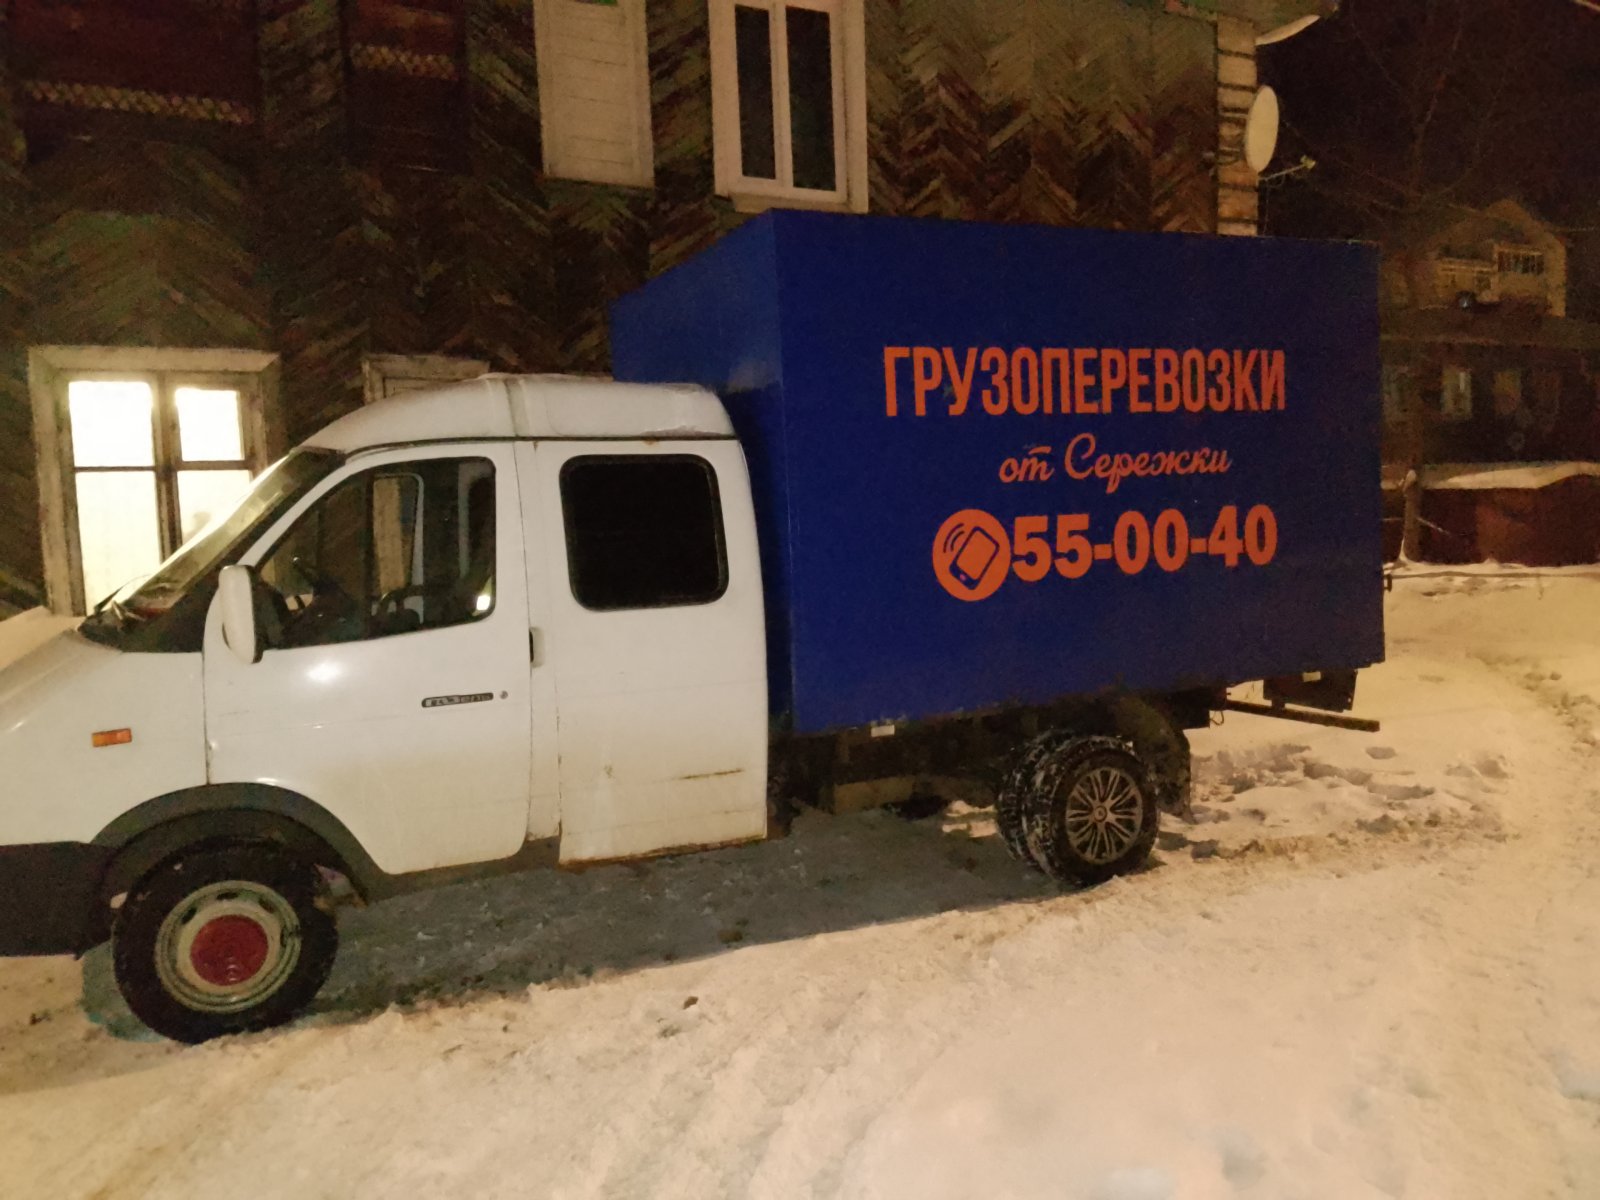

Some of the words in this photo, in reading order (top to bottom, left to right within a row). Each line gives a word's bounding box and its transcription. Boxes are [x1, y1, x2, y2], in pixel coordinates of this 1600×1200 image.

[884, 346, 1285, 416] ГРУЗОПЕРЕВОЗКИ
[999, 446, 1054, 483] от
[1064, 432, 1232, 494] Сережки
[1012, 504, 1278, 582] 55-00-40
